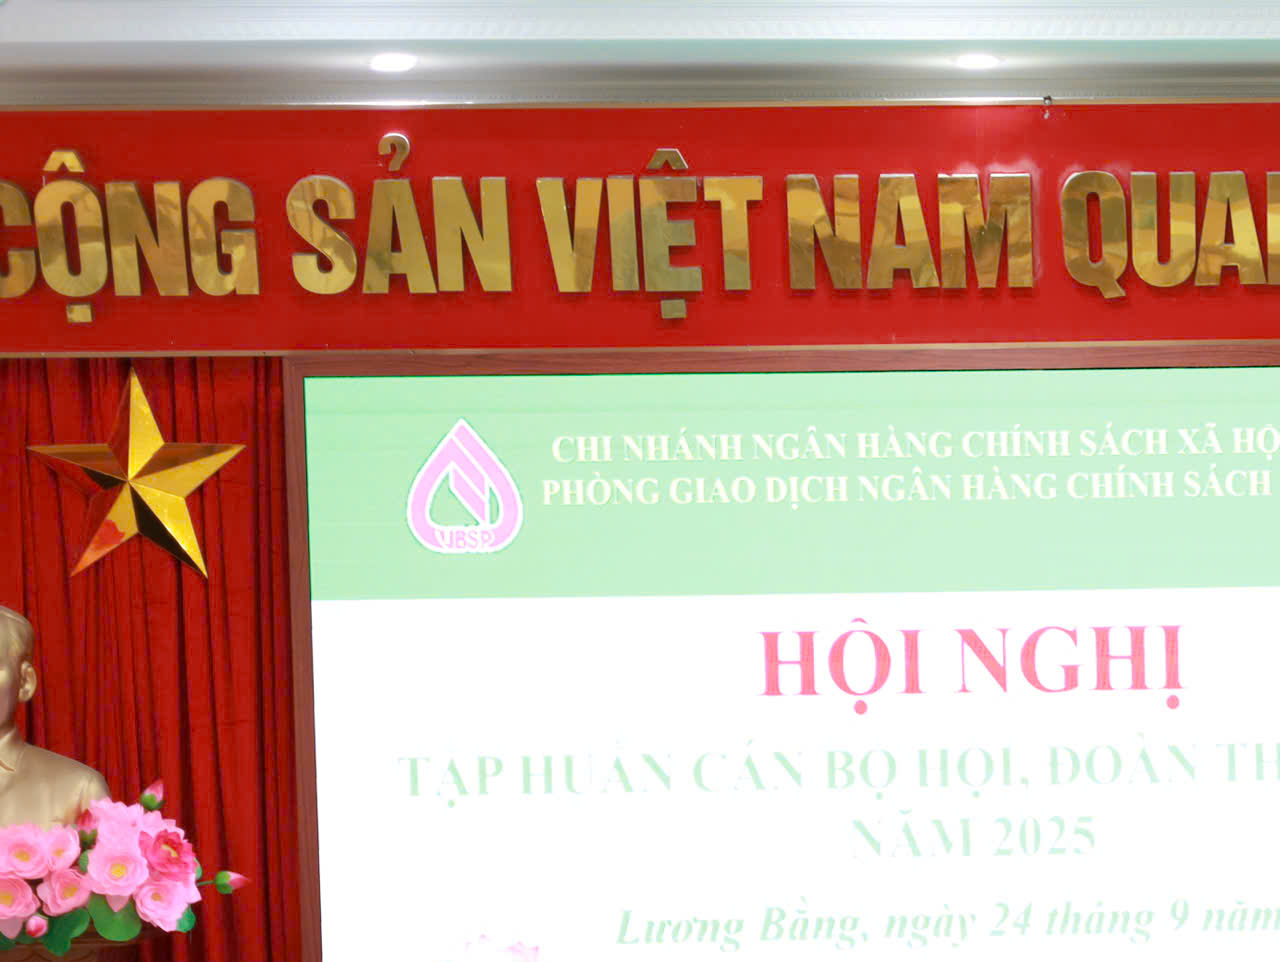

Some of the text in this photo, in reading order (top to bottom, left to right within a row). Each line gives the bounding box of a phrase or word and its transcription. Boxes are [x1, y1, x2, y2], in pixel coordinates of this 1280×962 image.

[286, 131, 512, 294] SẢN
[536, 147, 764, 320] VIỆT
[786, 172, 1034, 290] NAM
[551, 435, 613, 462] CHI
[622, 426, 744, 462] NHÁNH
[752, 425, 847, 460] NGÂN
[857, 424, 954, 459] HÀNG
[961, 422, 1071, 457] CHÍNH
[1079, 421, 1168, 456] SÁCH
[1176, 420, 1223, 455] XÃ
[541, 471, 661, 505] PHÒNG
[668, 474, 756, 504] GIAO
[765, 474, 850, 510] DỊCH
[858, 465, 953, 501] NGÂN
[961, 464, 1058, 500] HÀNG
[1065, 463, 1175, 499] CHÍNH
[1183, 462, 1272, 497] SÁCH
[756, 616, 1187, 716] HỘI NGHỊ
[852, 808, 1097, 858] NĂM 2025
[614, 907, 745, 953] Lương
[884, 903, 979, 949] ngày
[987, 902, 1034, 937] 24
[1045, 900, 1156, 944] tháng
[1167, 898, 1191, 931] 9
